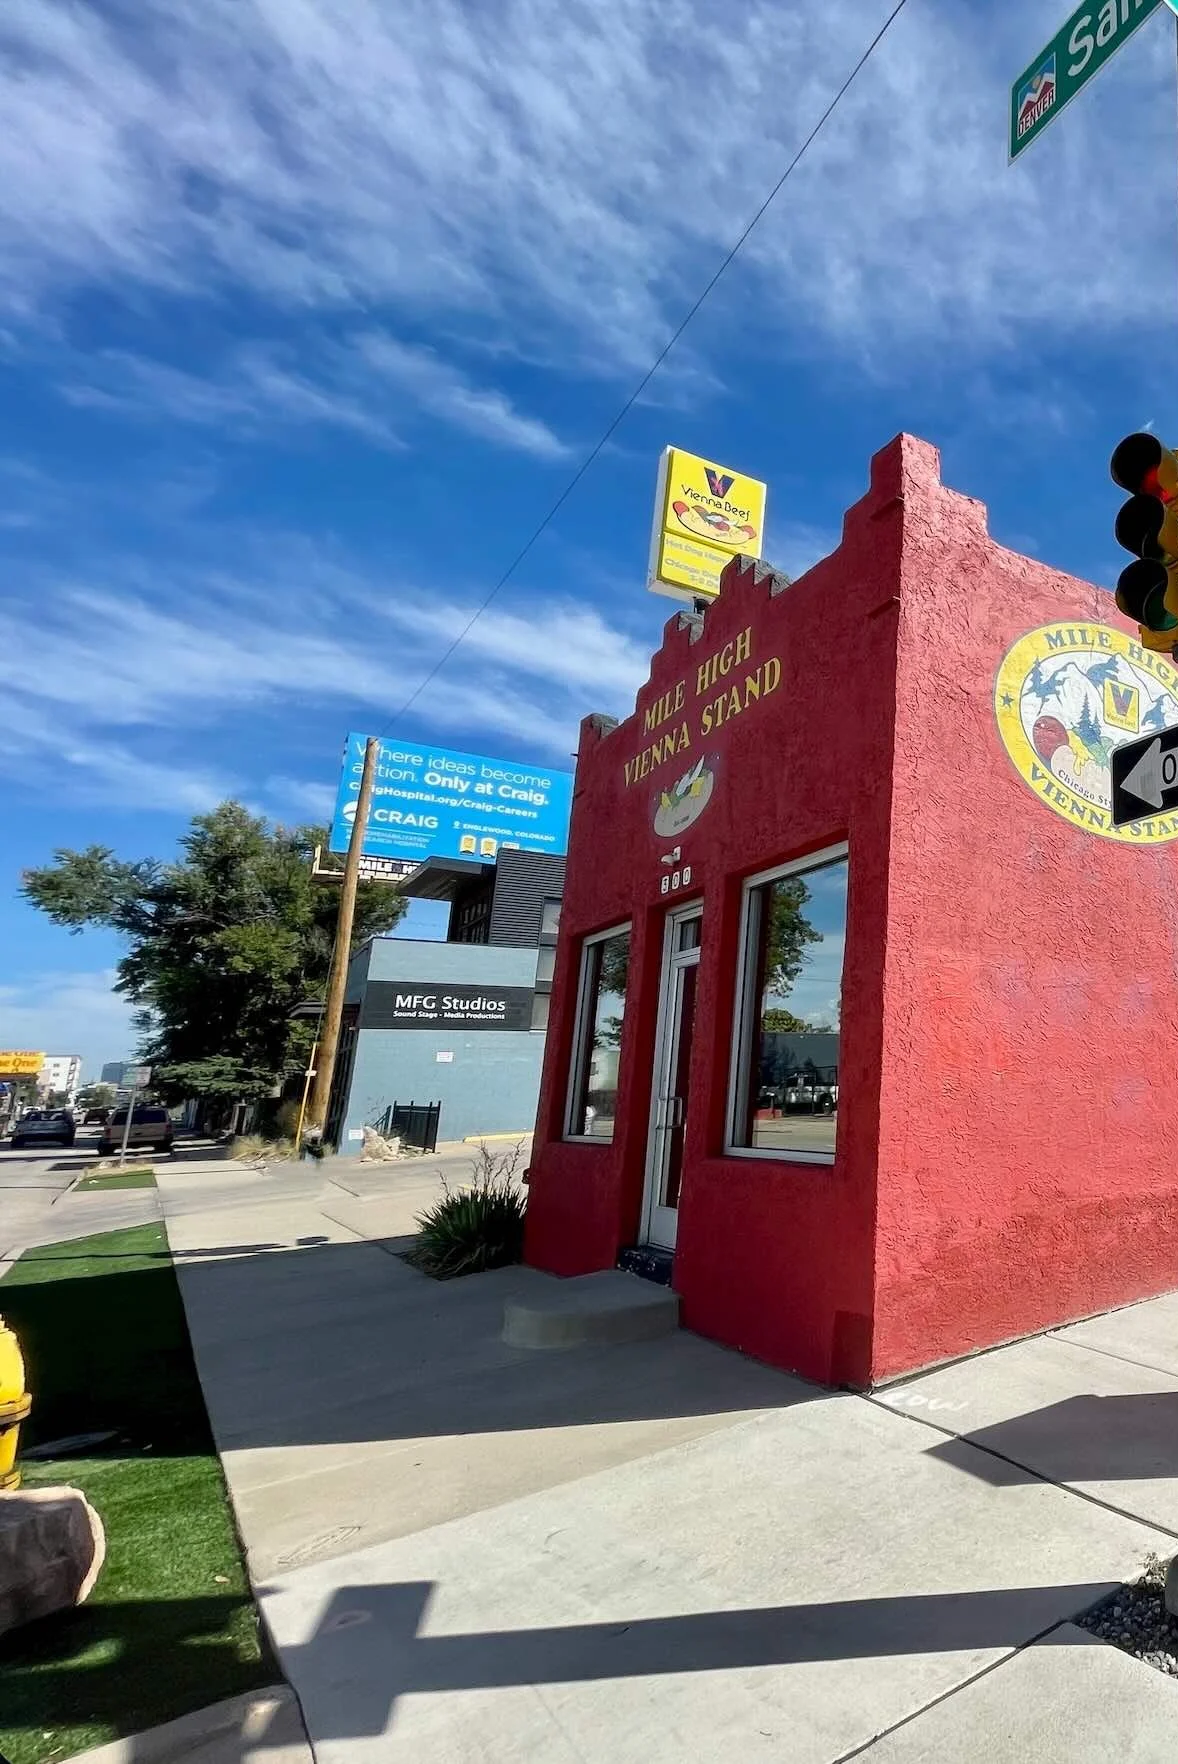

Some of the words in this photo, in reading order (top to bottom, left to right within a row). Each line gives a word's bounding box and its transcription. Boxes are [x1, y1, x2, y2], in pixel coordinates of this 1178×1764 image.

[1018, 89, 1054, 138] DENVER
[681, 484, 722, 509] Vienna
[724, 501, 750, 521] Beef
[1044, 628, 1112, 650] MILE
[644, 680, 686, 736] MILE
[696, 626, 752, 696] HIGH
[624, 722, 691, 787] VIENNA
[701, 657, 781, 736] STAND
[352, 762, 419, 783] ation.
[424, 772, 471, 793] Only
[474, 782, 494, 795] at
[498, 784, 549, 806] Craig.
[428, 755, 476, 776] ideas
[481, 763, 552, 789] become
[1058, 769, 1095, 800] Chicago
[374, 808, 439, 829] CRAIG
[662, 867, 691, 894] 300
[393, 1010, 417, 1018] Sound
[417, 1010, 438, 1019] Stage
[443, 1011, 465, 1019] Media
[466, 1012, 505, 1020] Productions
[395, 994, 437, 1010] MFG
[442, 996, 506, 1012] Studios
